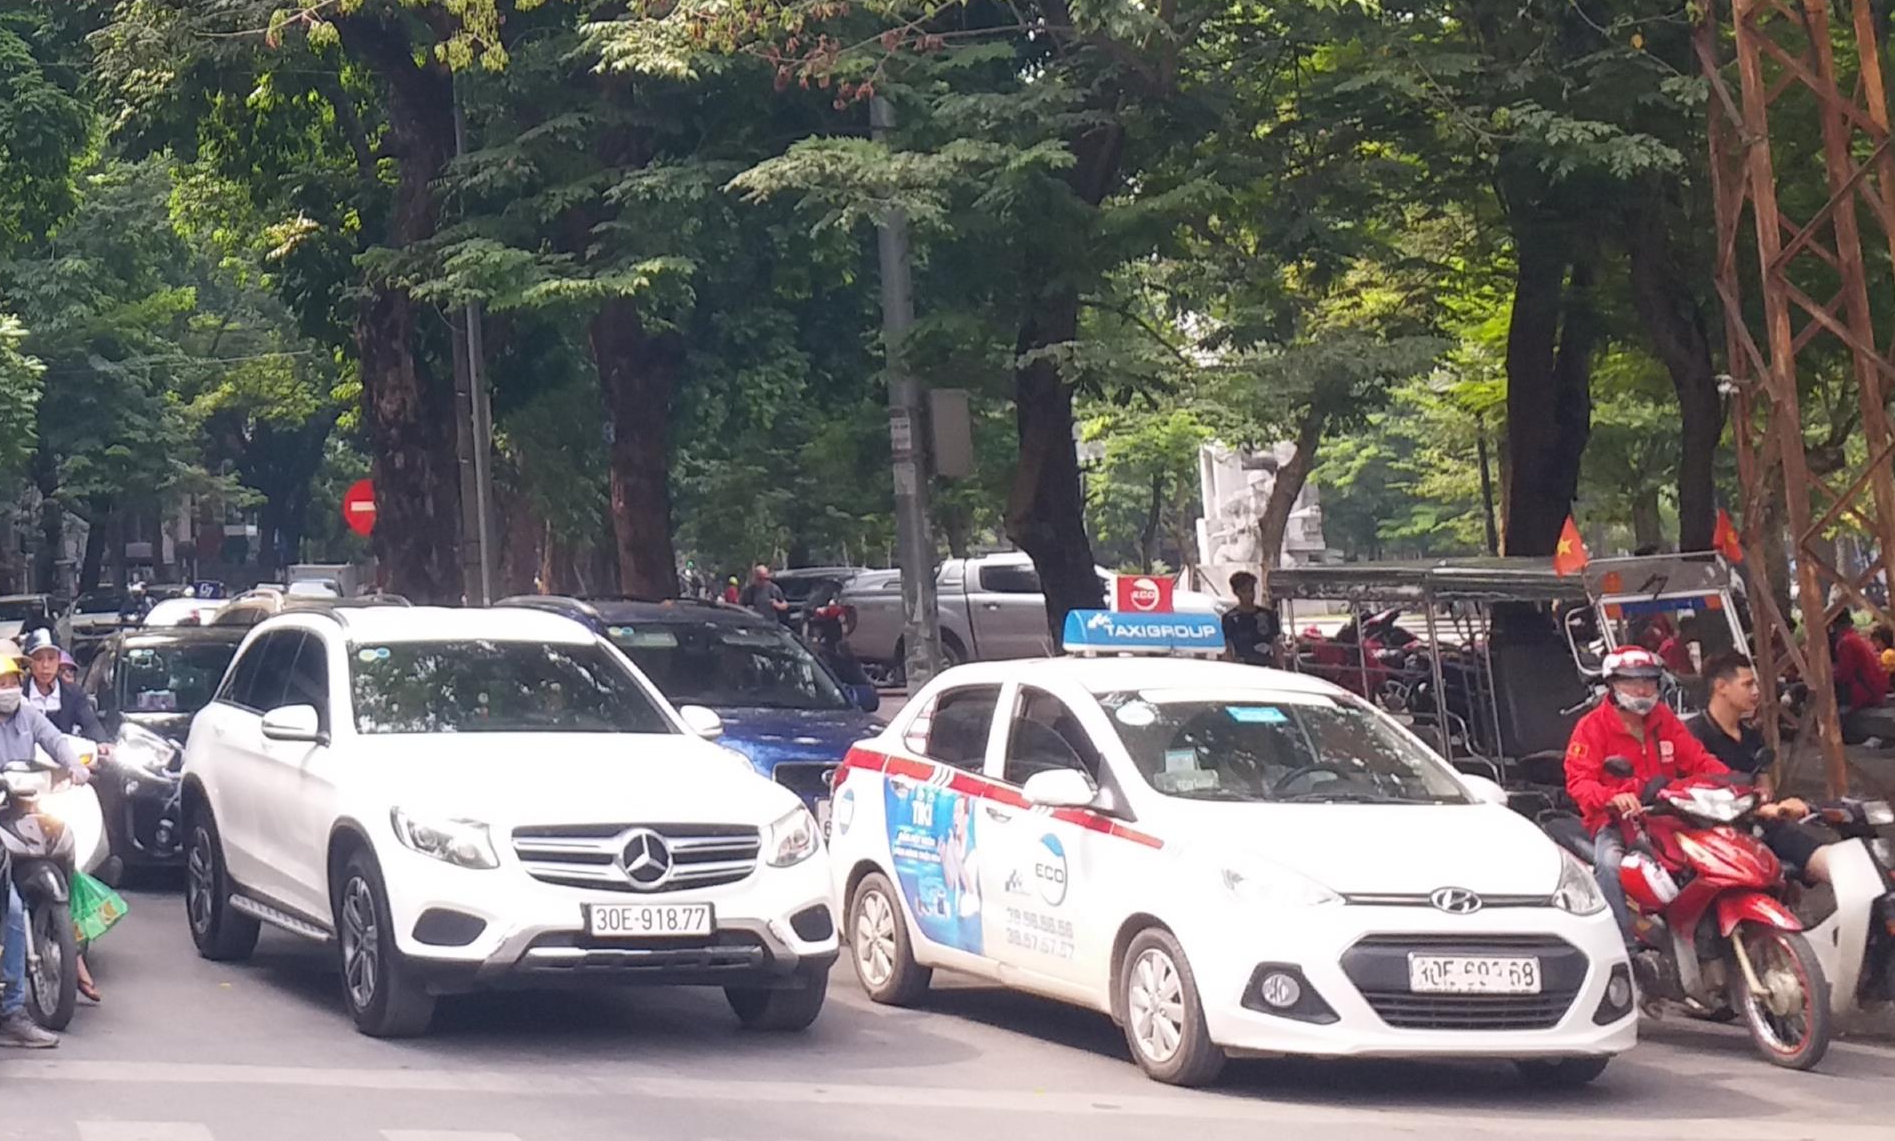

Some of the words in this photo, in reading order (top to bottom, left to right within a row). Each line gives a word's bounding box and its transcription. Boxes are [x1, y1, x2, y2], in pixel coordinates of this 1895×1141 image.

[1105, 624, 1217, 639] TAXIGROUP
[1035, 862, 1065, 884] ECO
[595, 907, 706, 931] 30E-918.77
